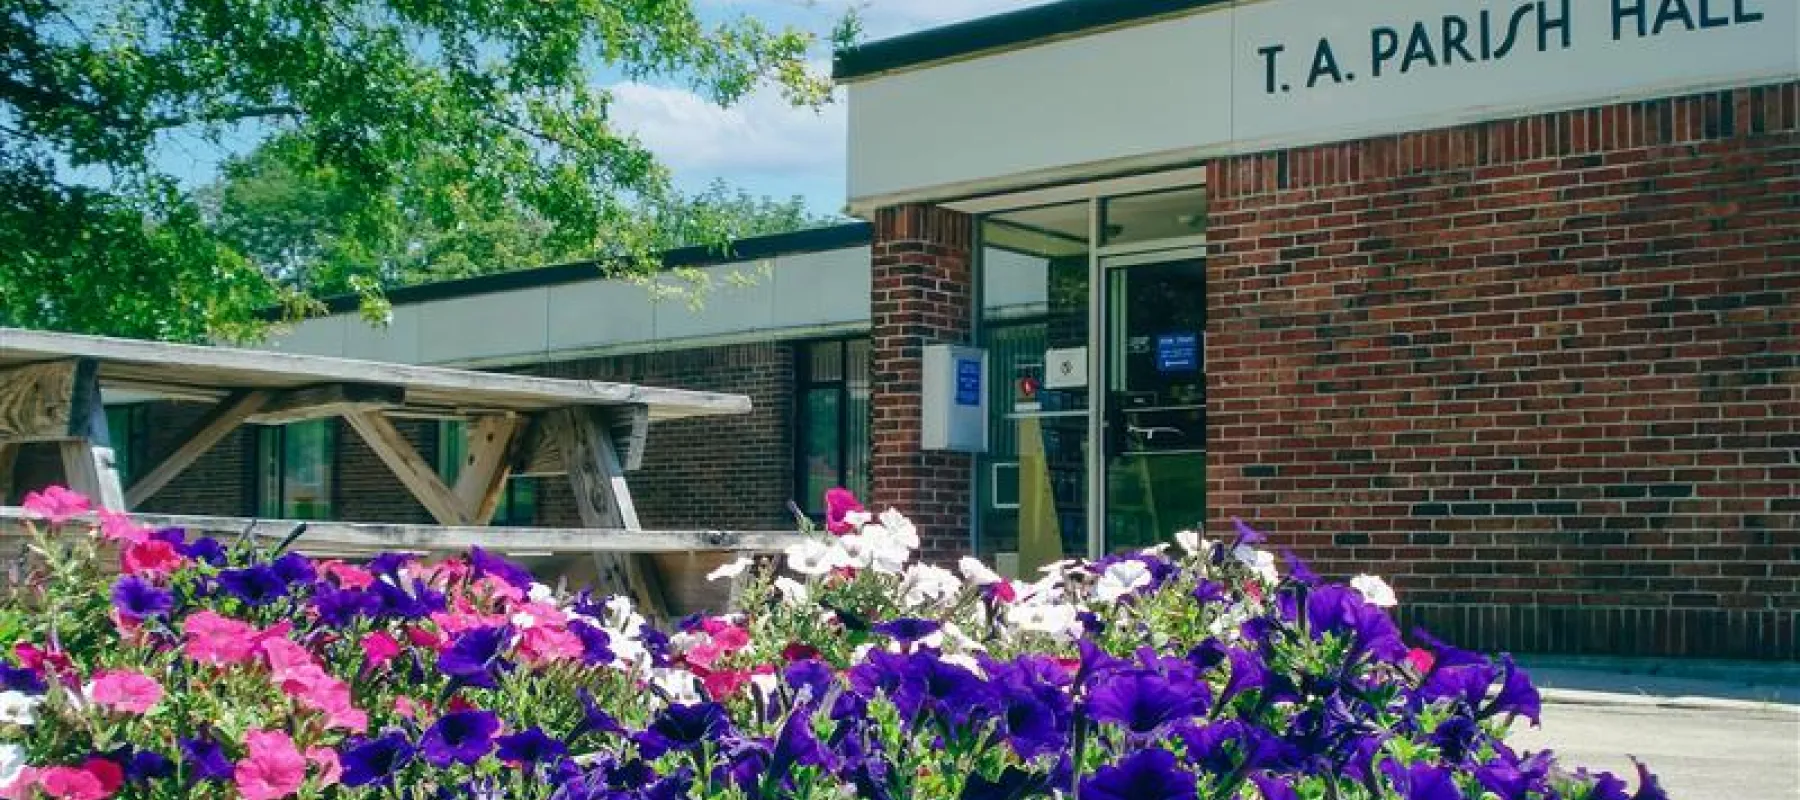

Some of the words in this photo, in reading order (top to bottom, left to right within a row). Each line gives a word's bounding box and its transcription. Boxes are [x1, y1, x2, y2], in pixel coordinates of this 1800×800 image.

[1258, 45, 1289, 94] T.
[1307, 38, 1355, 87] A.
[1371, 0, 1572, 77] PARISH
